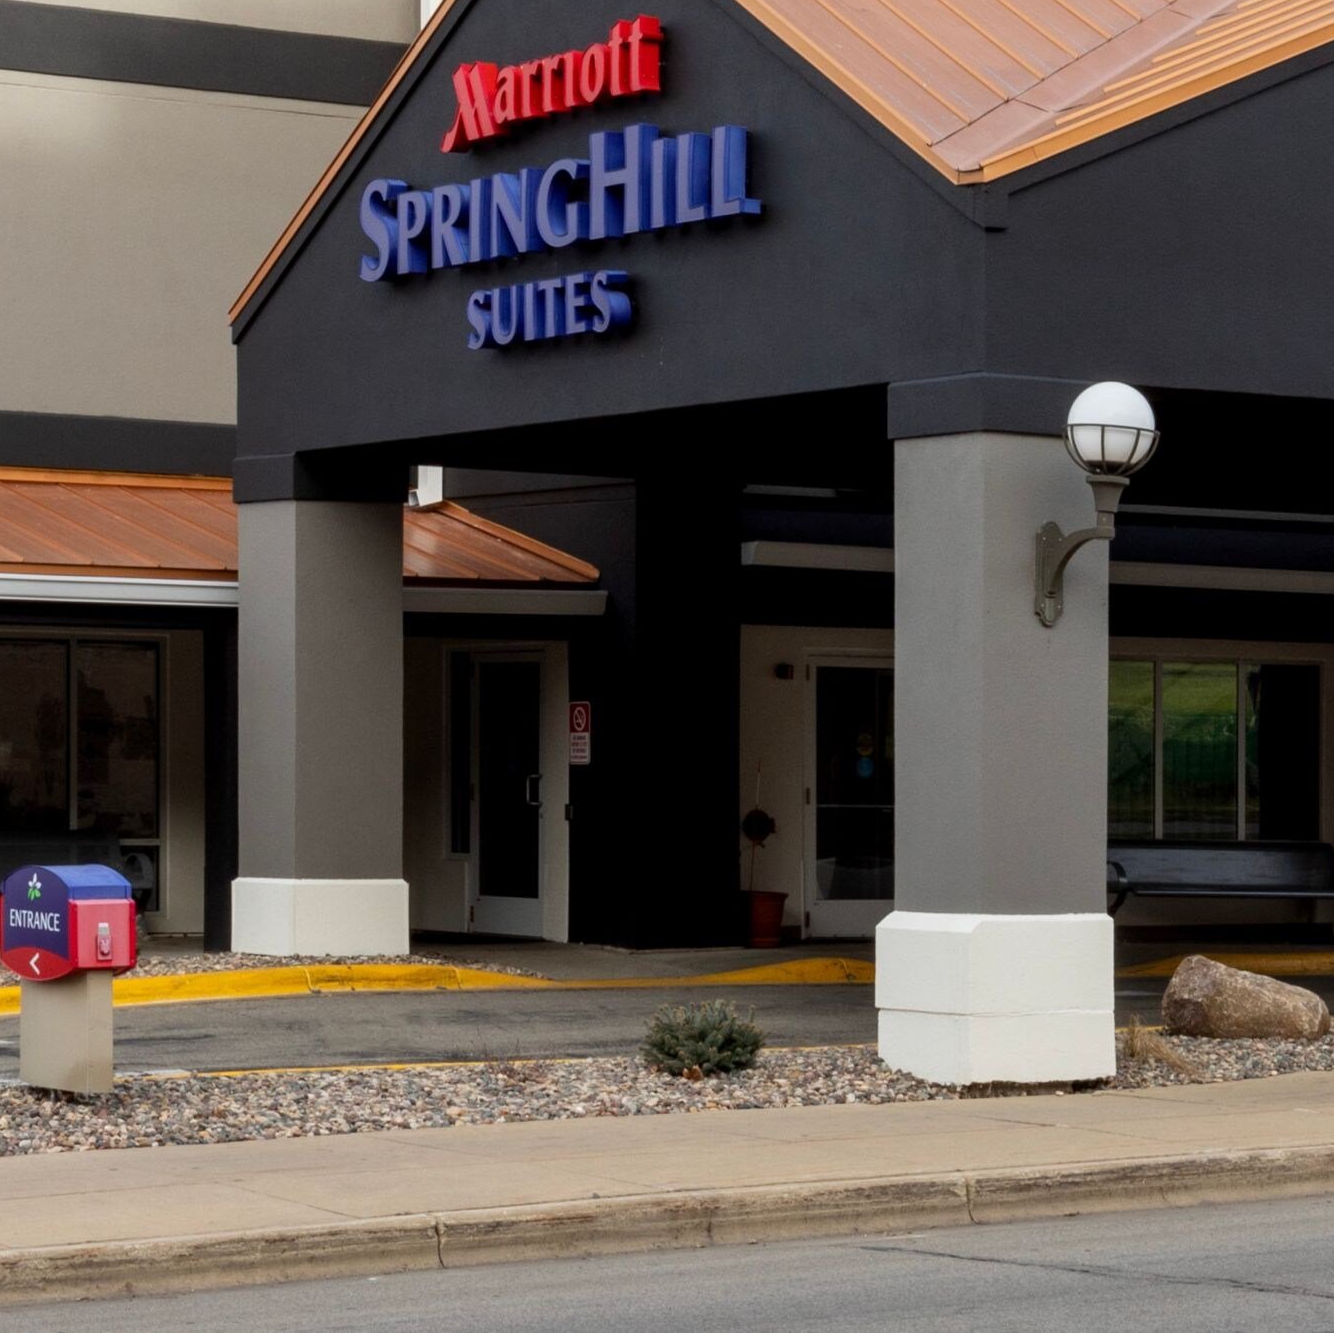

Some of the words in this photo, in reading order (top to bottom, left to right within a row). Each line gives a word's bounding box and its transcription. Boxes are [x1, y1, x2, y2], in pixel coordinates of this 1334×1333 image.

[440, 14, 666, 154] Marriott
[358, 123, 762, 282] SPRINGHILL
[466, 270, 632, 350] SUITES
[10, 908, 60, 932] ENTRANCE
